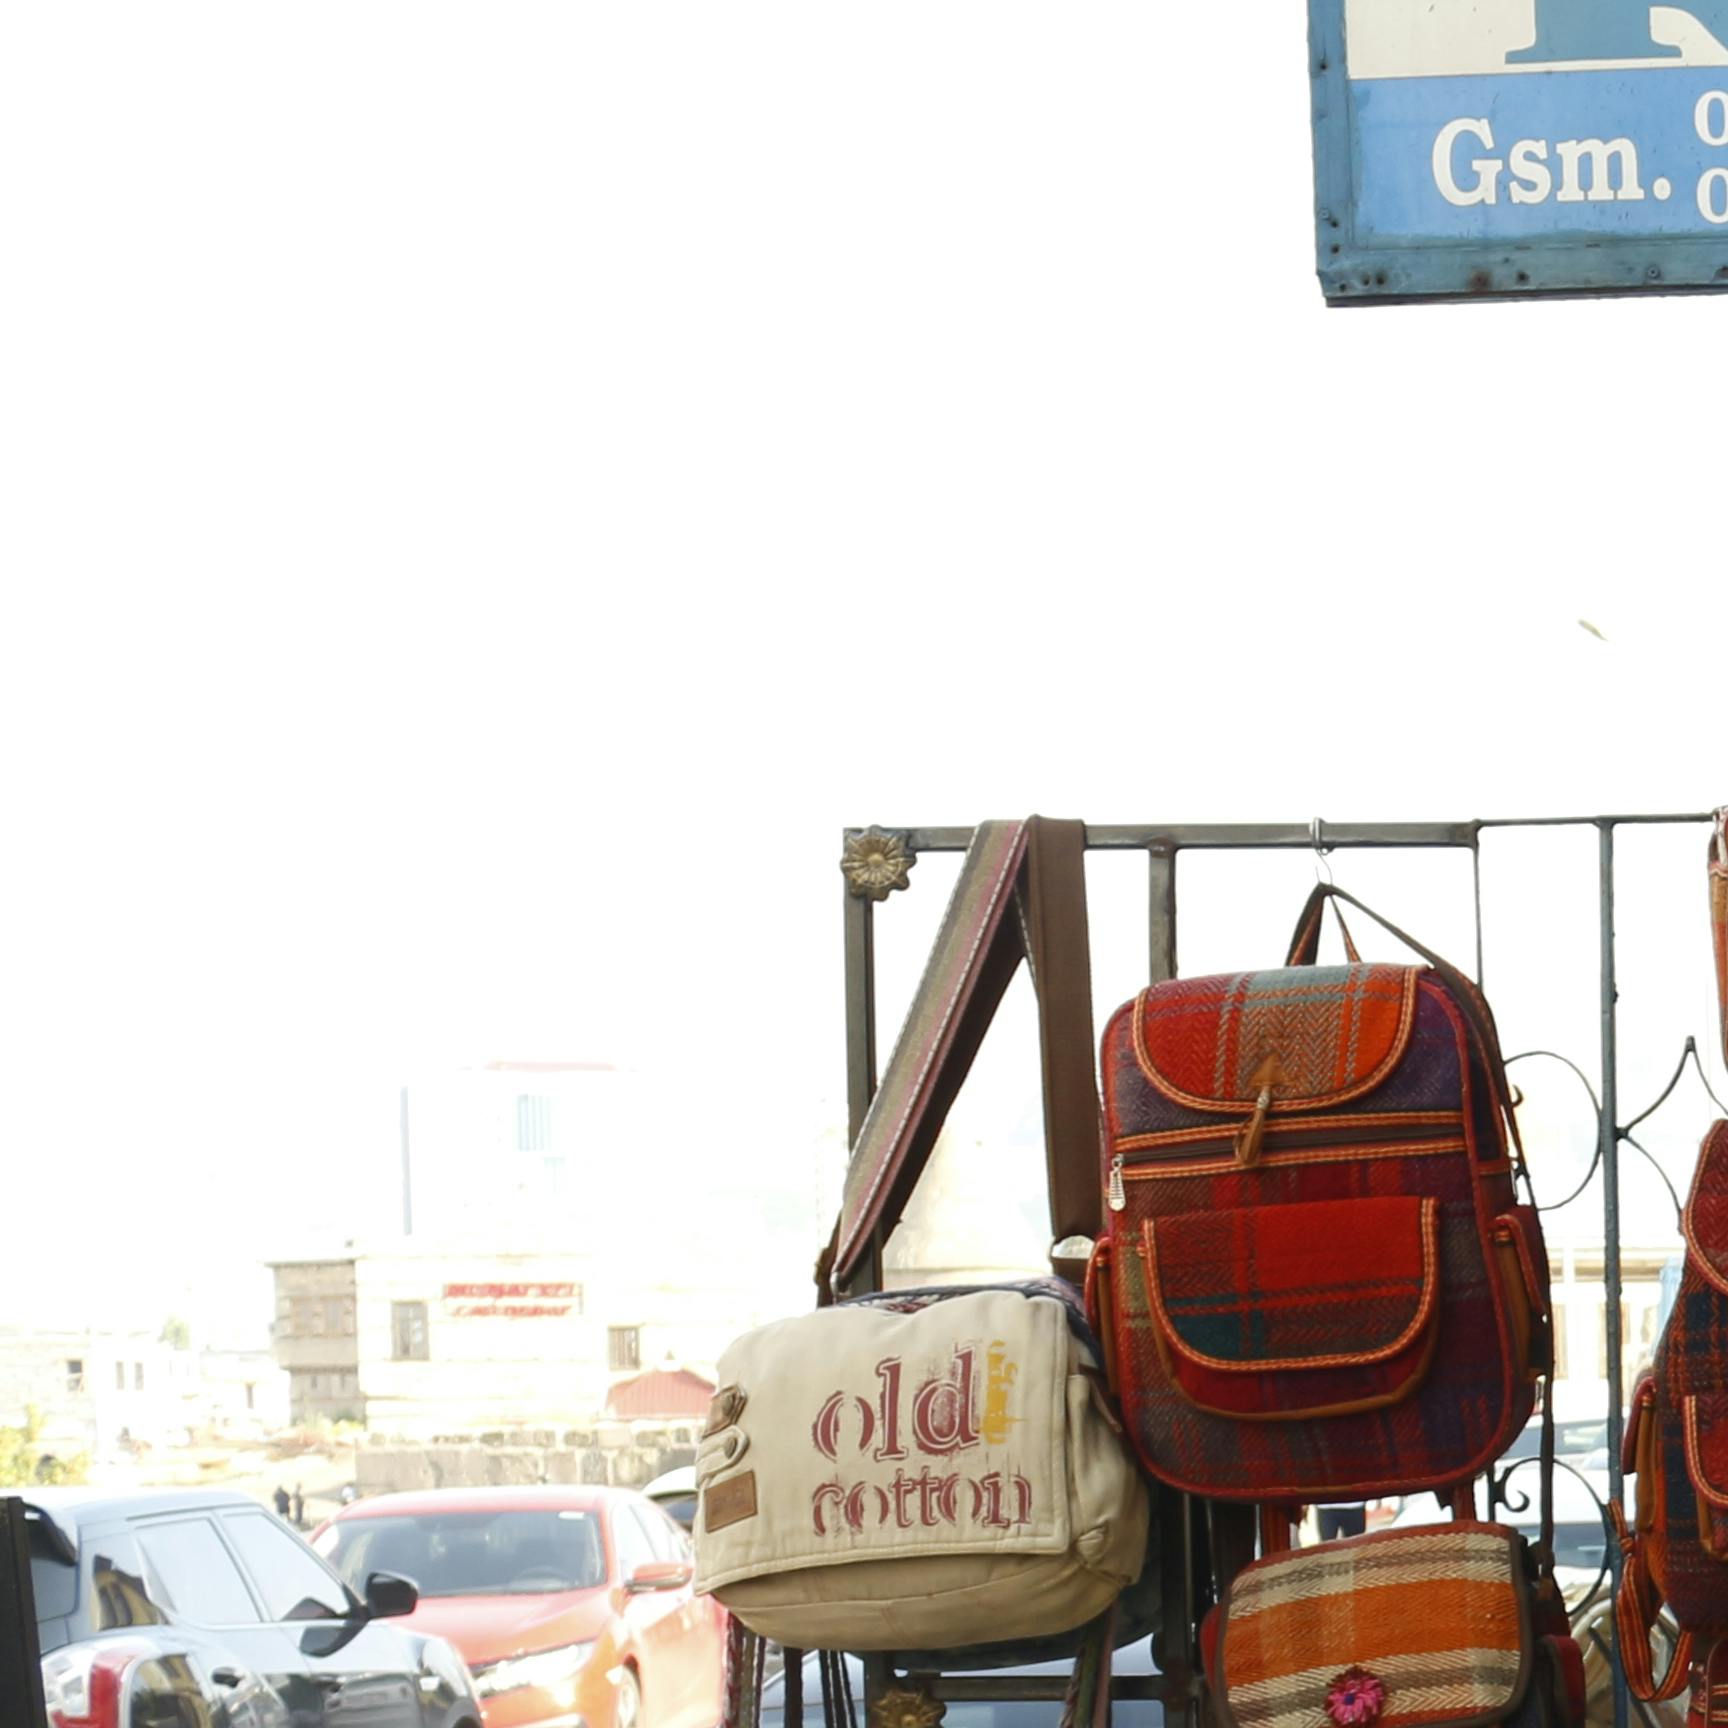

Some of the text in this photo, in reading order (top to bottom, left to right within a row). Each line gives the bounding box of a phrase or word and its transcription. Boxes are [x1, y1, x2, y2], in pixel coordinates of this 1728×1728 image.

[1431, 117, 1671, 206] Gsm.
[812, 1342, 981, 1463] old
[812, 1464, 1033, 1538] cotton
